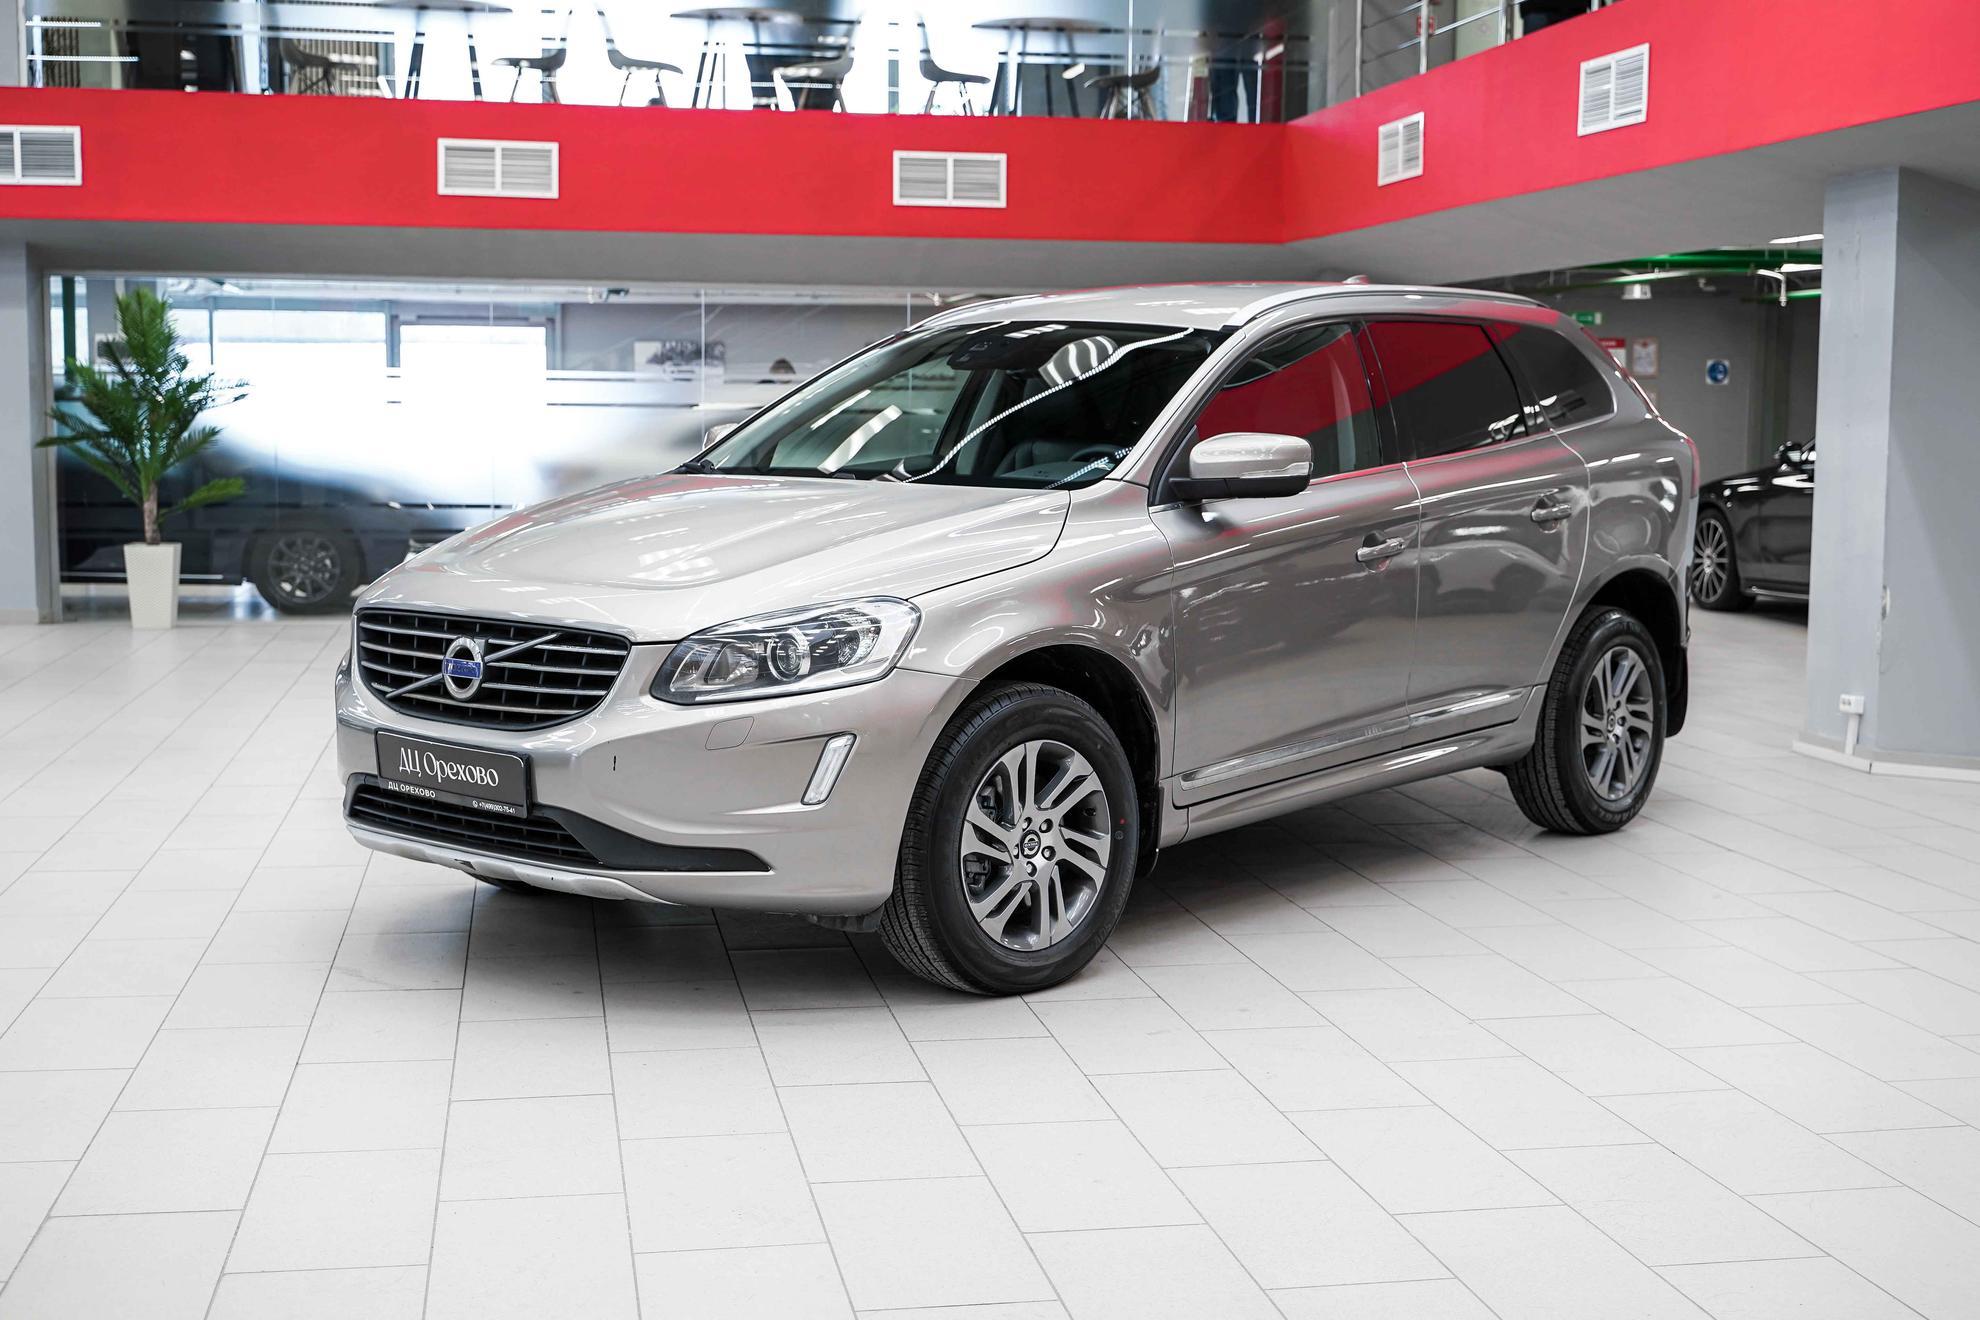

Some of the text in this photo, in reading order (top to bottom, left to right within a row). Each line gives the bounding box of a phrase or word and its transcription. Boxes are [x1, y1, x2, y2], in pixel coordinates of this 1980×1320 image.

[399, 747, 499, 786] ДЦ Орехово
[388, 781, 436, 798] ДЦ ОРЕХОВО
